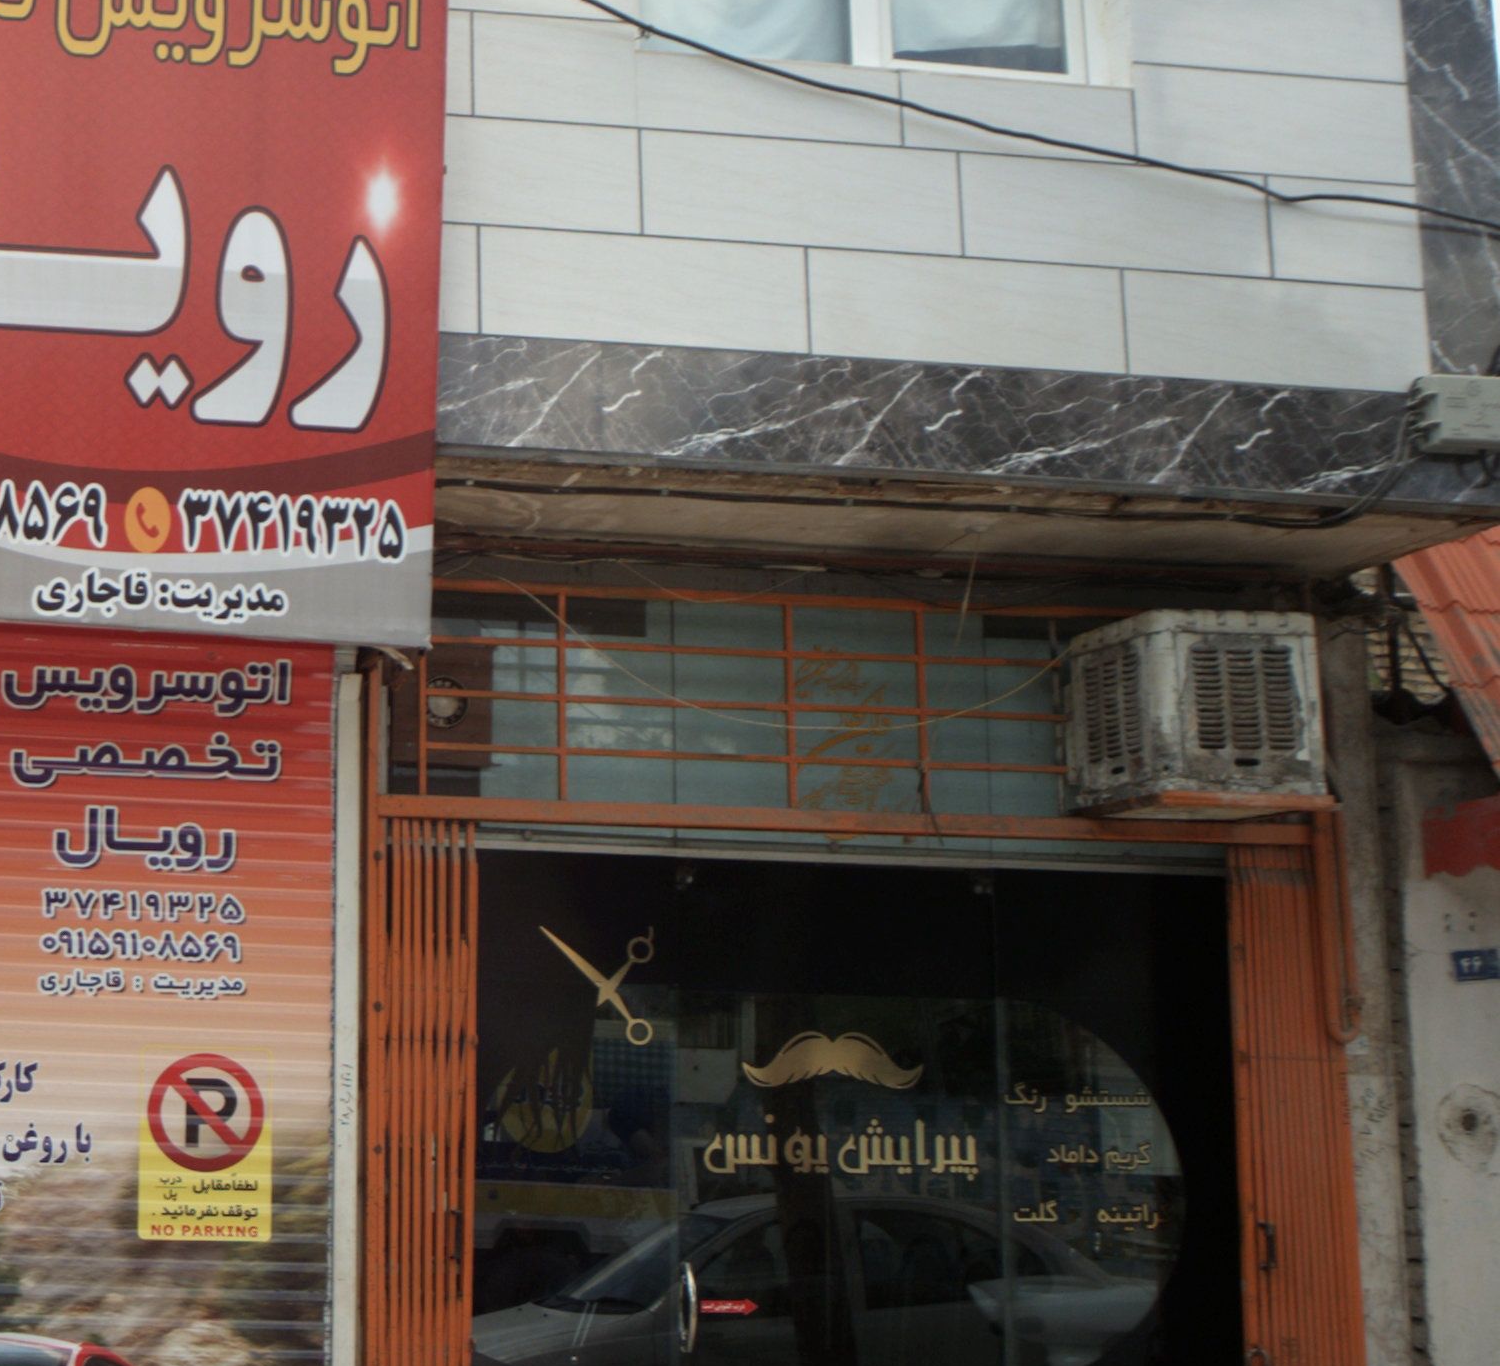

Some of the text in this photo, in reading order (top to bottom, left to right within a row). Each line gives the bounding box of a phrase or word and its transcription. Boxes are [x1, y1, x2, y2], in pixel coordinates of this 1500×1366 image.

[179, 488, 406, 562] ۳۷۴۱۹۳۲۵
[36, 569, 149, 614] قاجاری
[1, 659, 293, 716] اتوسرویس
[10, 733, 282, 787] تخصصی
[53, 806, 238, 871] رویال
[43, 888, 245, 925] ۳۷۴۱۹۳۲۵
[41, 930, 241, 963] ۰۹۱۵۹۱۰۸۵۶۹
[38, 969, 124, 996] قاجاری
[153, 973, 246, 997] مدیریت
[1, 1123, 69, 1166] روغن
[73, 1122, 92, 1155] با
[704, 1113, 828, 1176] یونس
[150, 1224, 259, 1237] NO PARKING
[221, 1204, 258, 1220] توقف
[1096, 1203, 1162, 1232] راتینه
